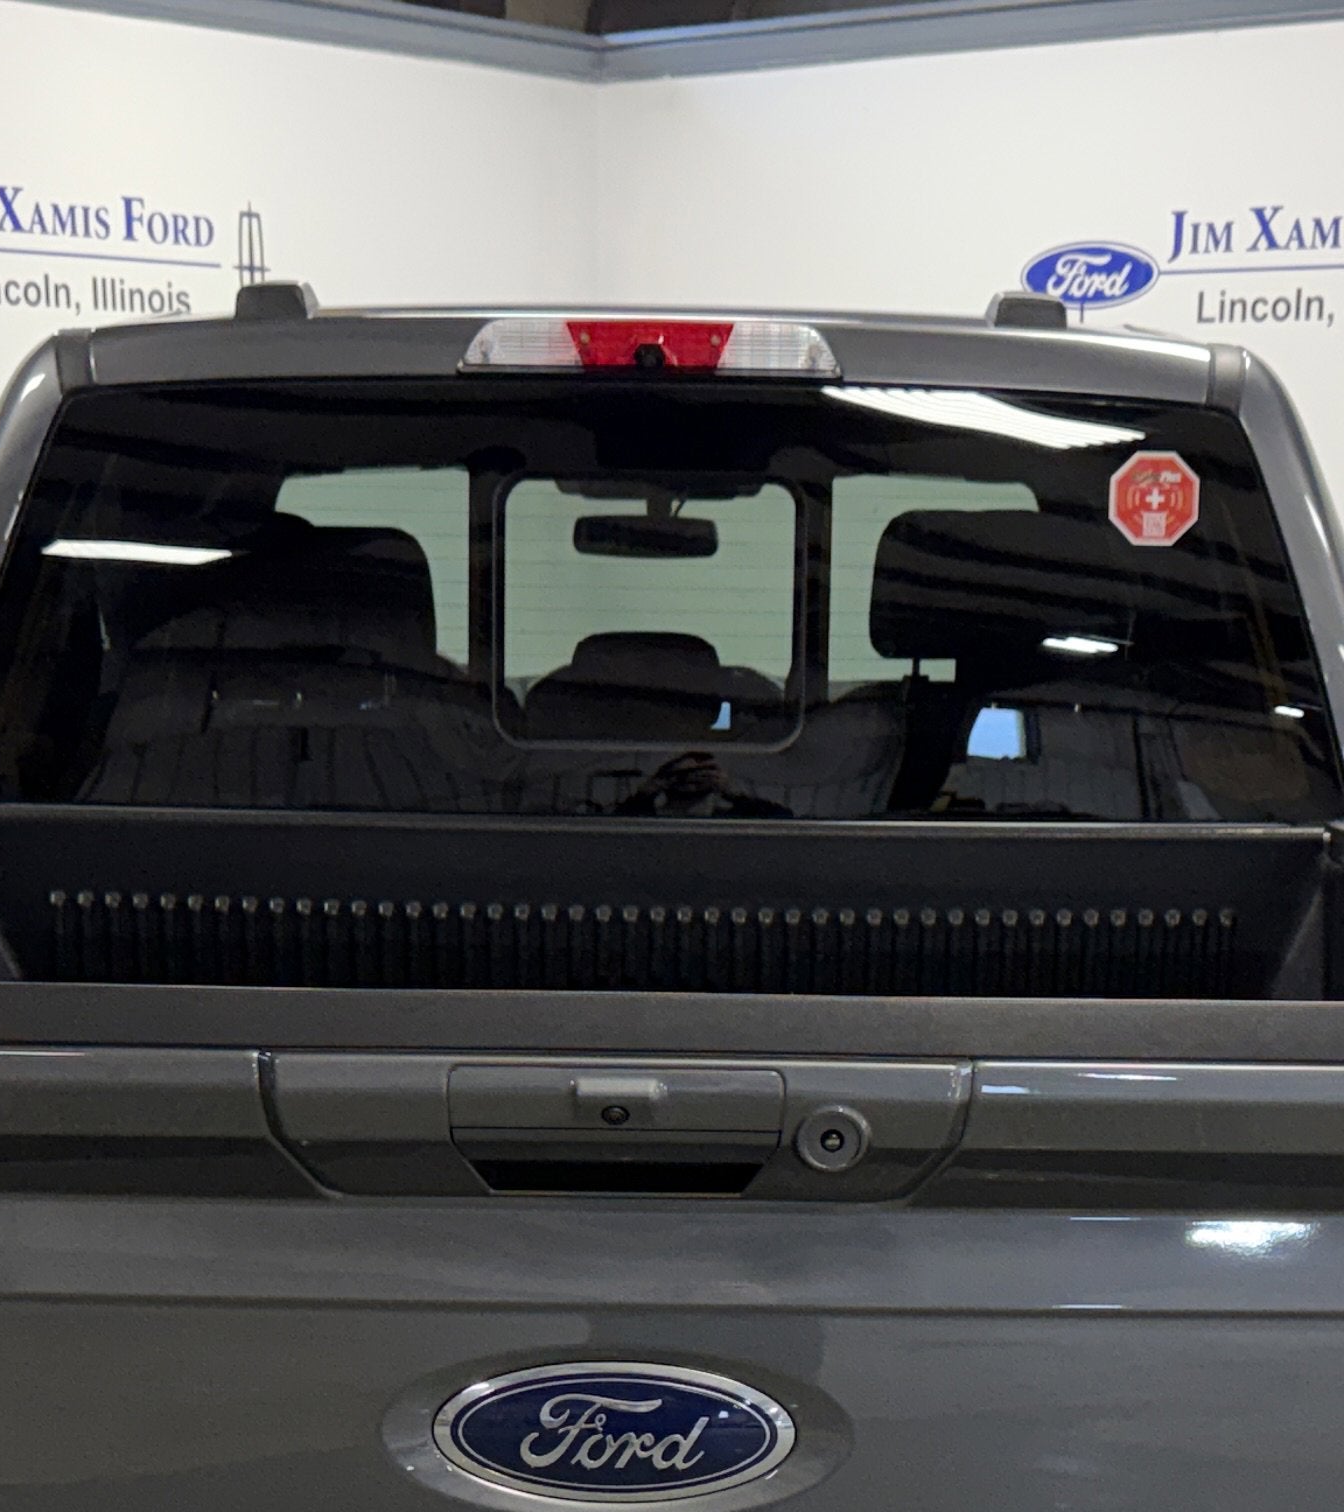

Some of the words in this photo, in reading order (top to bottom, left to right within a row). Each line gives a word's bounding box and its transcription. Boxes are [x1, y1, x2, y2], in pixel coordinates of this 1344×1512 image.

[120, 195, 215, 249] FORD
[1168, 210, 1234, 263] JIM
[91, 276, 192, 315] Illinois
[1046, 253, 1130, 300] Ford
[1196, 289, 1336, 328] Lincoln,
[519, 1392, 710, 1470] Ford
